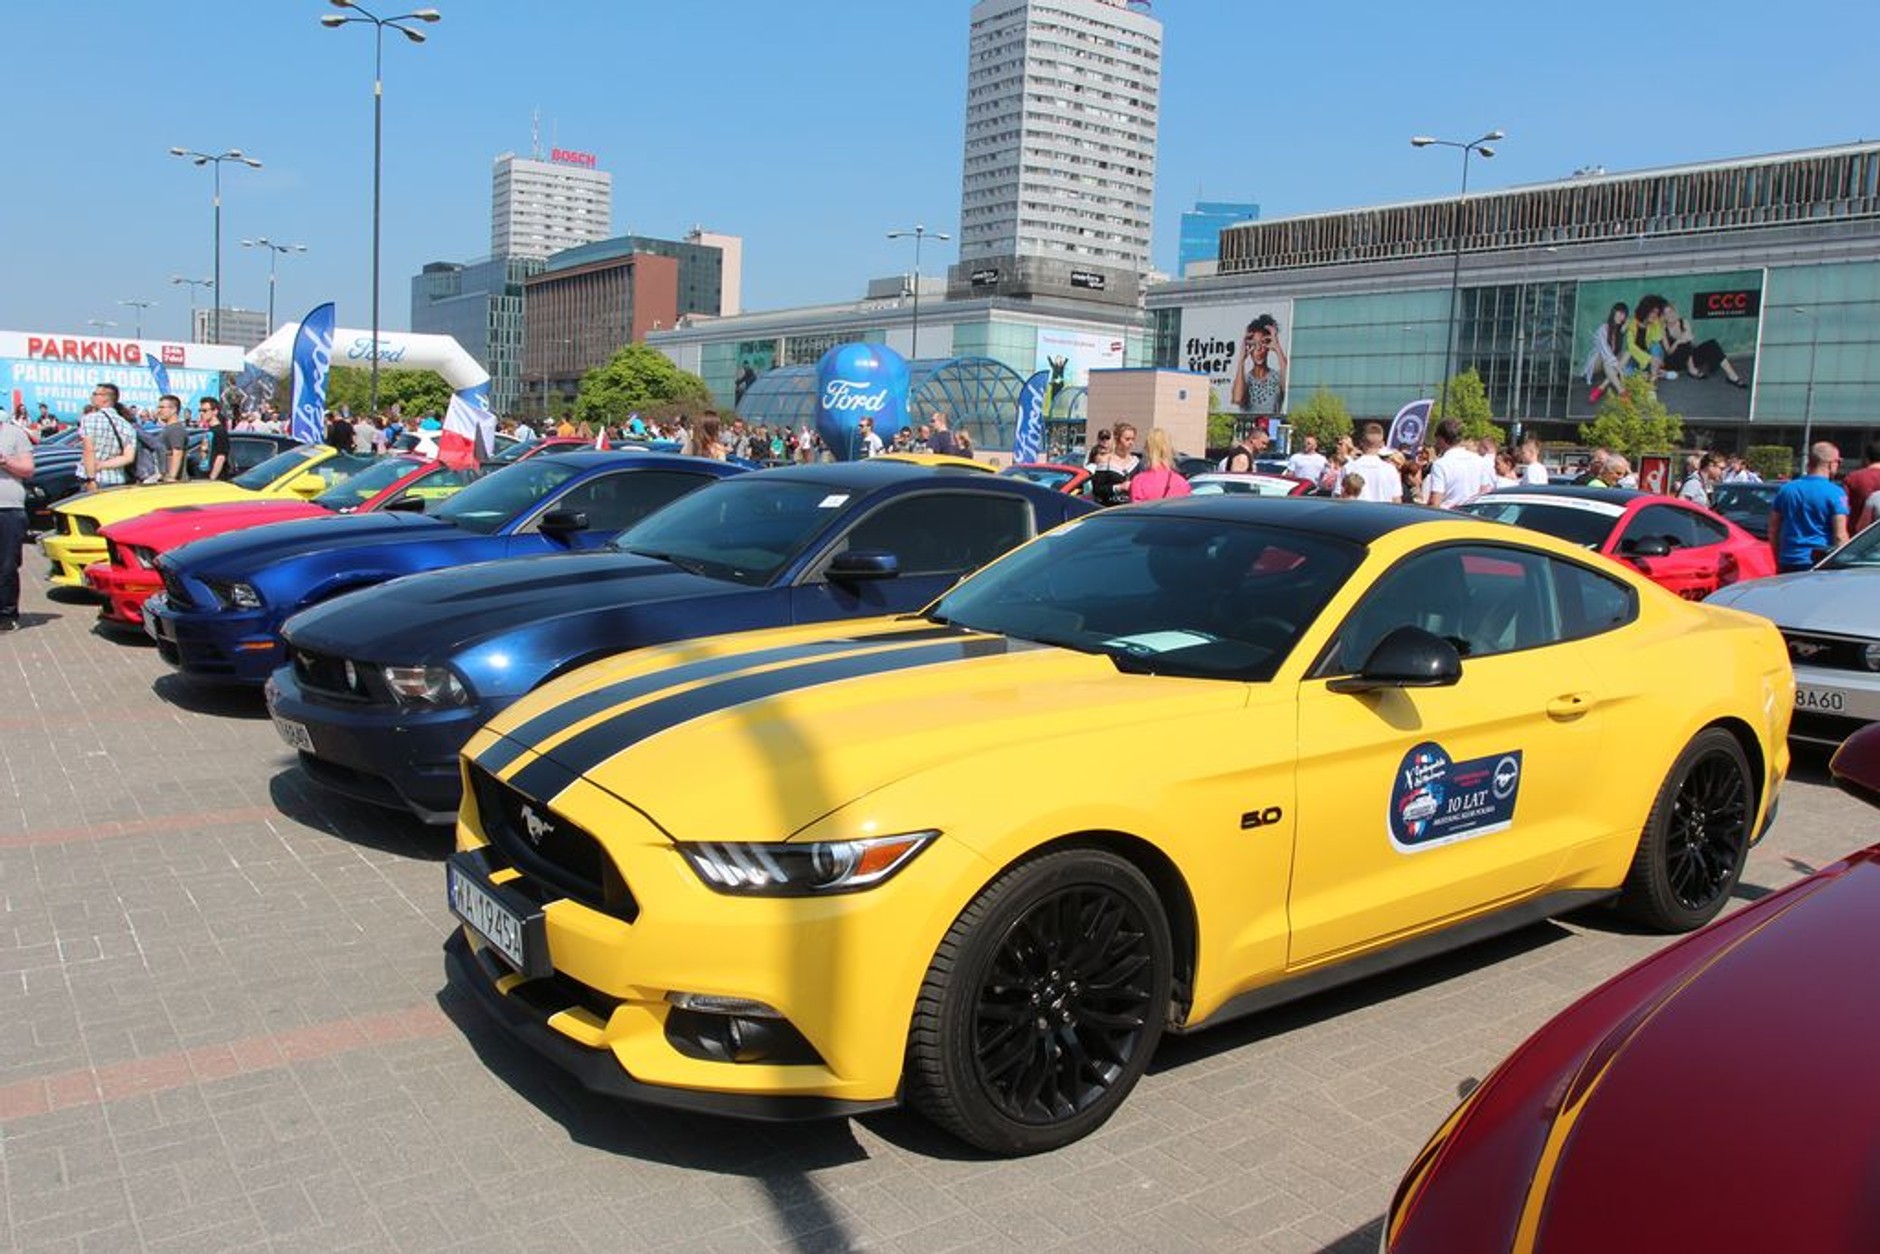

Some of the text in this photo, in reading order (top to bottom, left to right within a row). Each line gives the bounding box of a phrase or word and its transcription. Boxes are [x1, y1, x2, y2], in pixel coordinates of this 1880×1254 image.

[552, 148, 596, 167] BOSCH
[1708, 293, 1747, 310] CCC
[28, 337, 141, 363] PARKING
[347, 338, 406, 362] Ford
[1186, 337, 1235, 359] flying
[11, 362, 98, 386] PARKING
[1188, 356, 1232, 373] tiger
[823, 380, 887, 411] Ford
[1014, 384, 1044, 463] Ford
[1447, 790, 1489, 813] 10 LAT
[1241, 806, 1283, 830] 5.0
